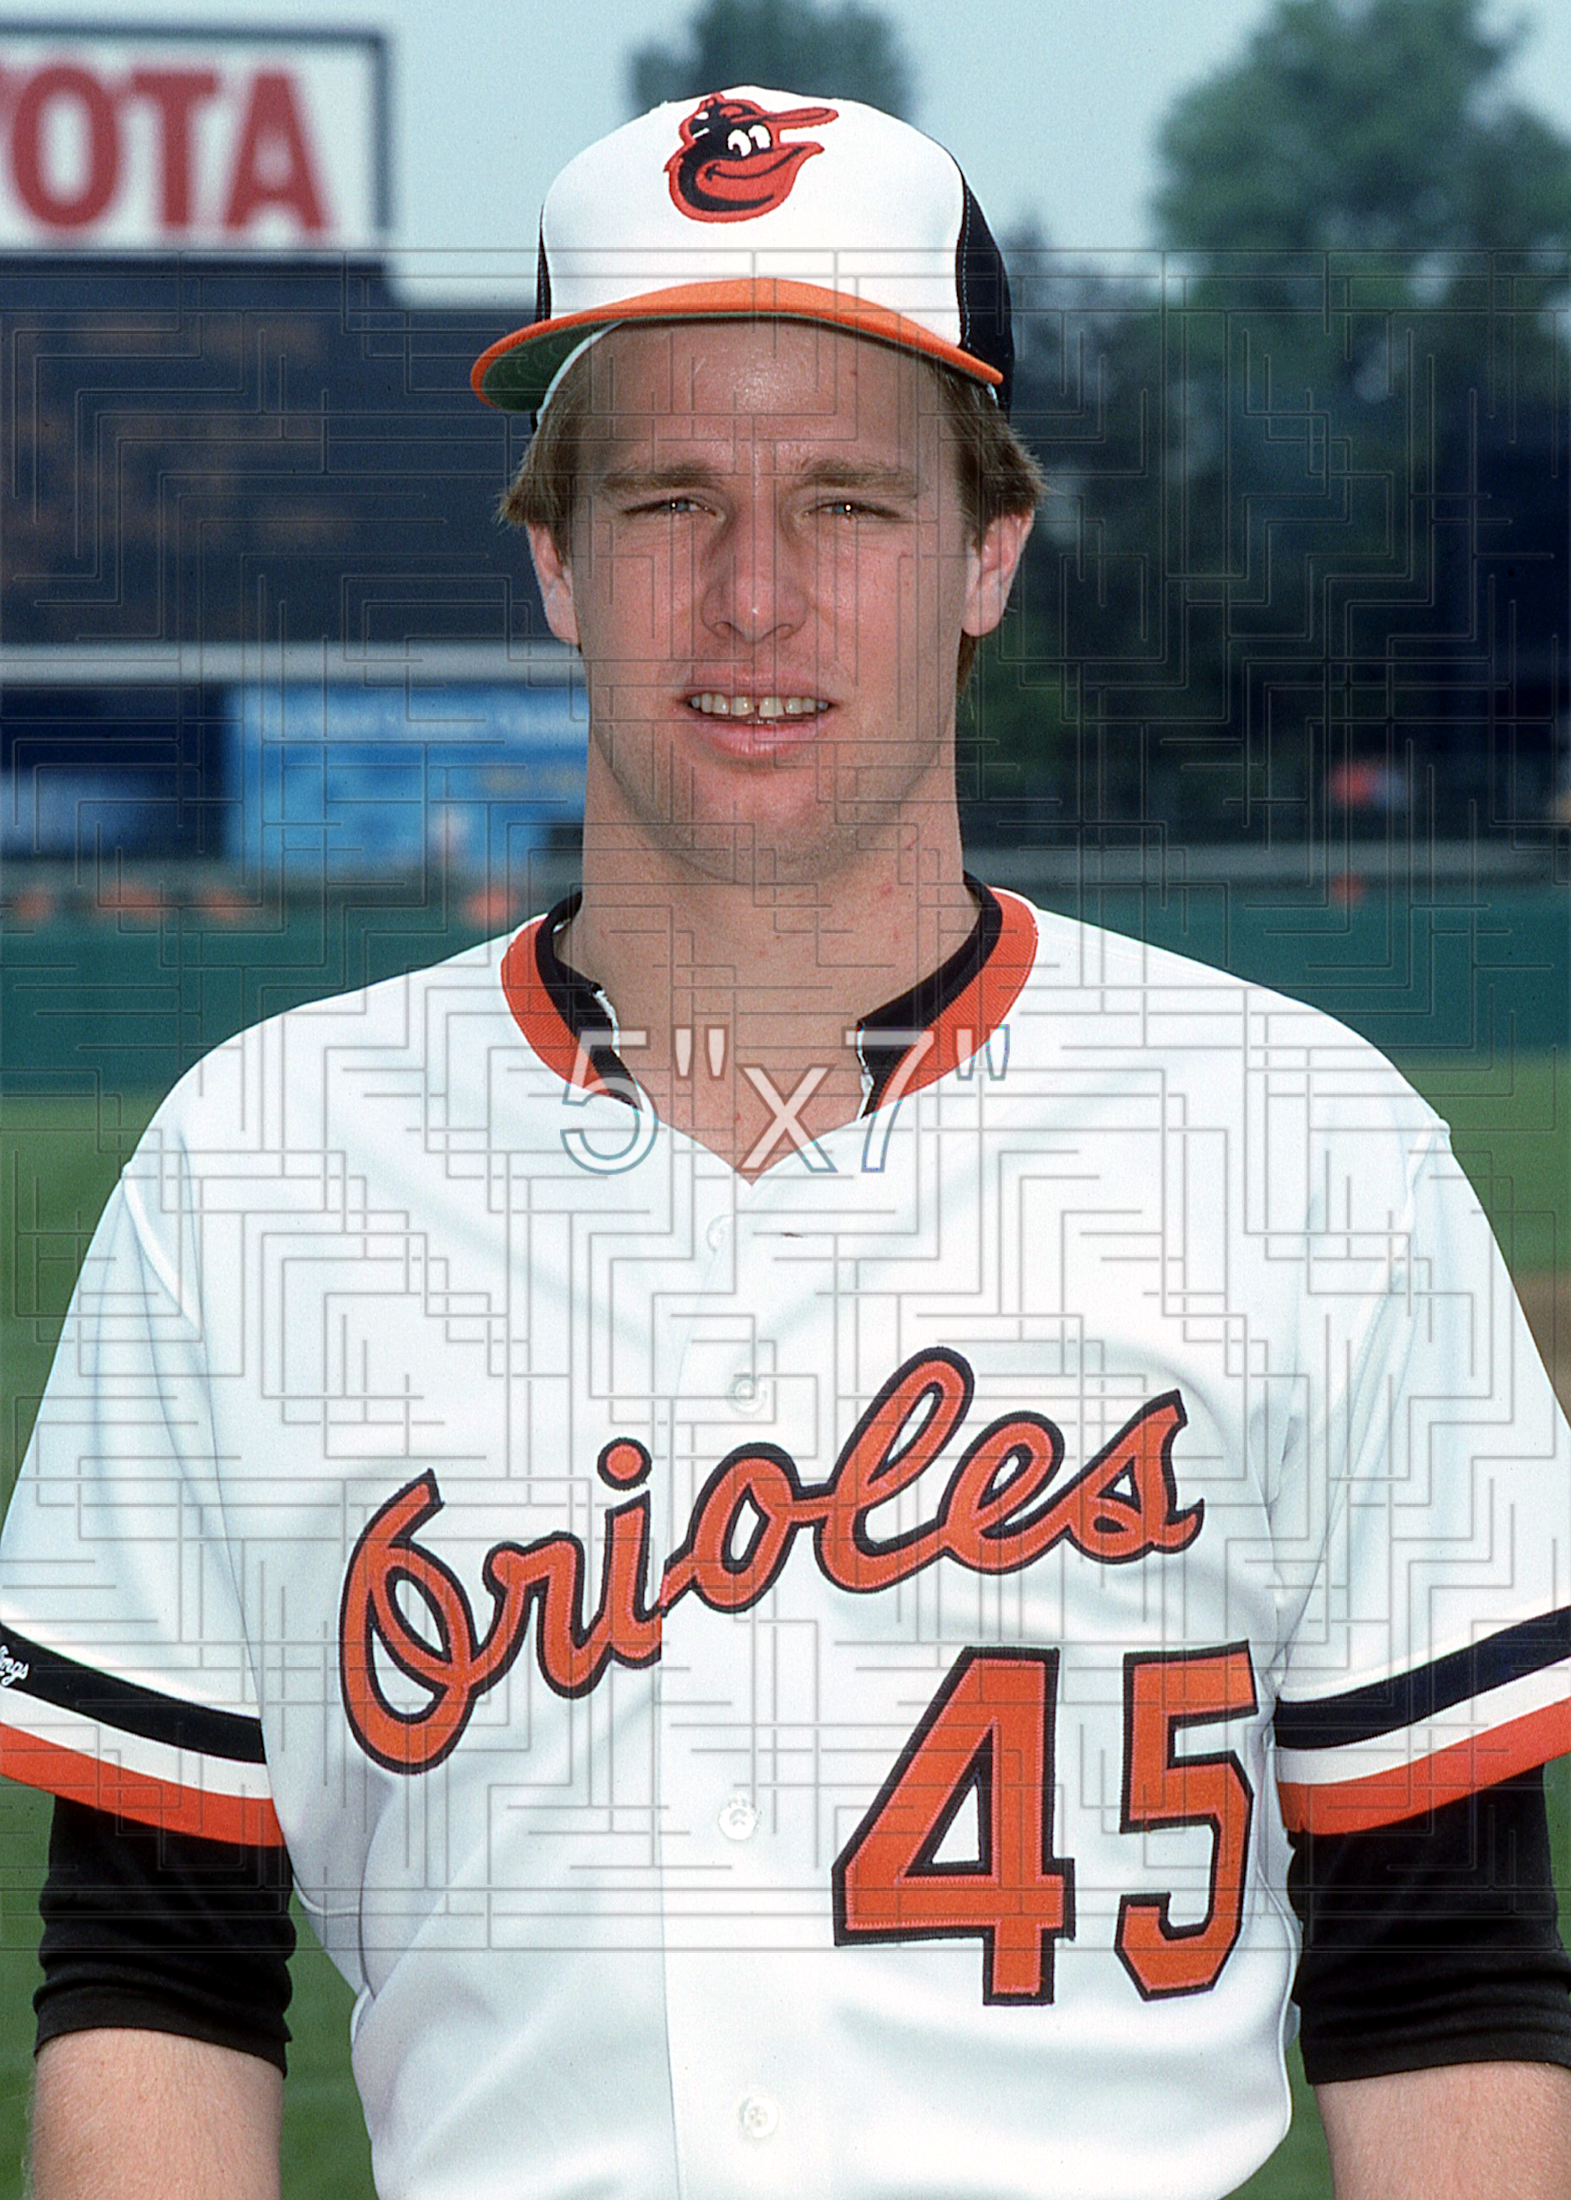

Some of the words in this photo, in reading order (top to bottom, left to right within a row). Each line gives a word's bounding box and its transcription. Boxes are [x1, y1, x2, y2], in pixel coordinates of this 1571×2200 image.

[0, 64, 327, 232] OTA
[339, 1346, 1204, 1774] Orioles
[831, 1640, 1259, 2006] 45
